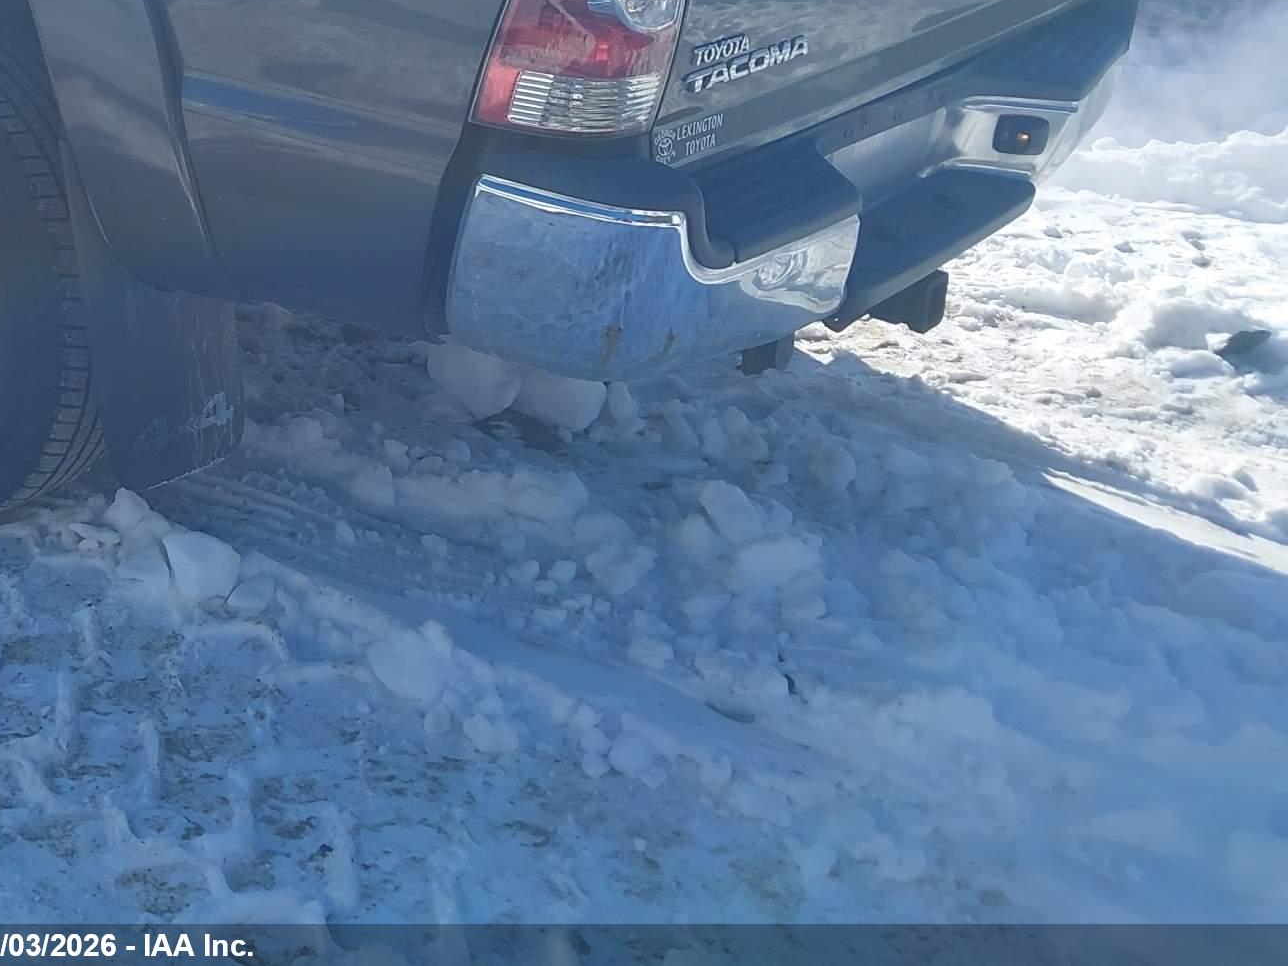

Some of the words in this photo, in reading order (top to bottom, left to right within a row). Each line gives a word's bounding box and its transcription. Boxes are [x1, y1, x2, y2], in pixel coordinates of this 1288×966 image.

[685, 35, 809, 94] TACOMA
[693, 34, 750, 67] TOYOTA
[676, 113, 724, 141] LEXINGTON
[685, 133, 716, 156] TOYOTA
